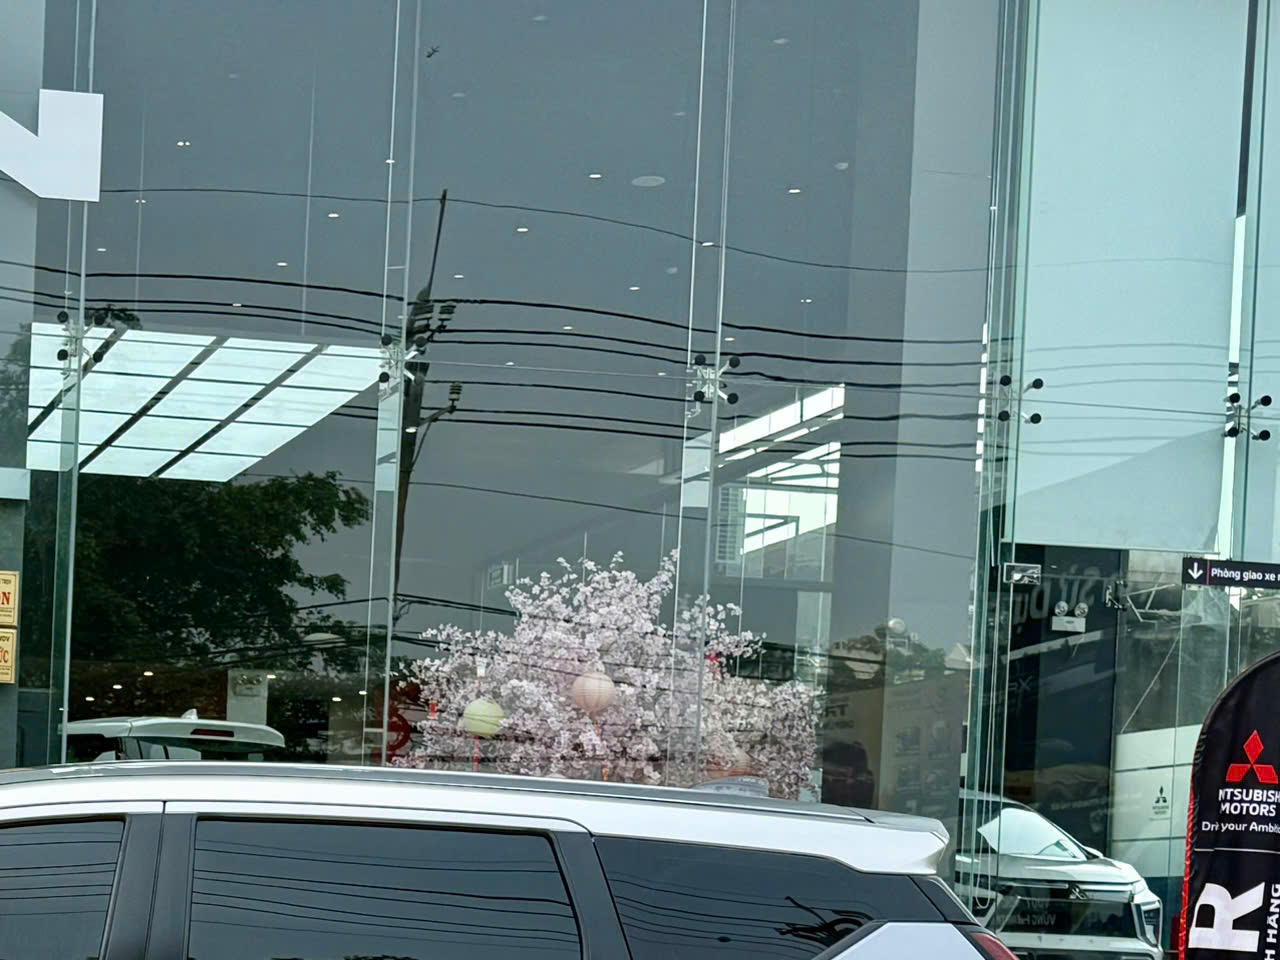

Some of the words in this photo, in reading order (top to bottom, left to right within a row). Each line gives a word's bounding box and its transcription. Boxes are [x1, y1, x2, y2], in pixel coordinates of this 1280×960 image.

[1211, 568, 1241, 581] Phòng
[1242, 570, 1263, 581] giao
[1264, 573, 1276, 581] xe
[1221, 823, 1248, 833] your
[1266, 883, 1280, 944] HÃNG
